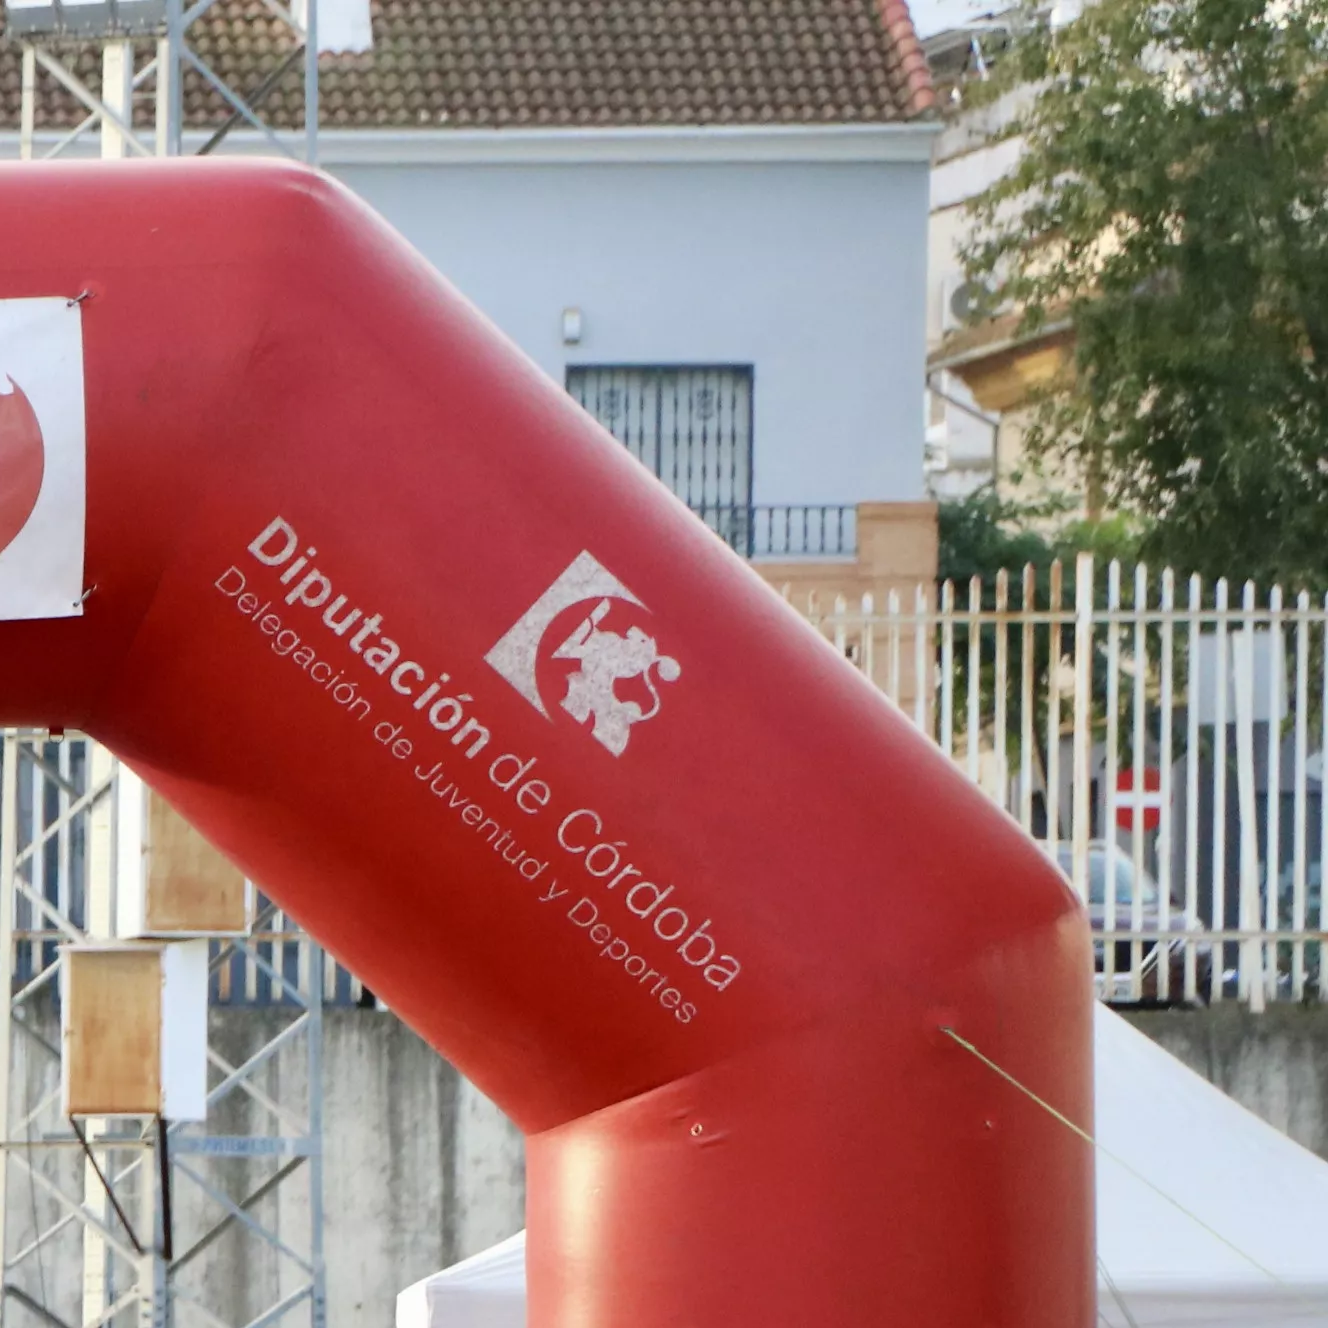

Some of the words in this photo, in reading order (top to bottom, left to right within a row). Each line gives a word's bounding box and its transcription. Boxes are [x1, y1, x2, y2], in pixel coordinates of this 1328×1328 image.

[214, 566, 371, 722] Delegación
[373, 719, 414, 760] de
[414, 761, 548, 881] Juventud
[538, 878, 569, 903] y
[567, 896, 697, 1024] Deportes
[247, 516, 491, 759] Diputación
[488, 753, 551, 814] de
[557, 808, 742, 992] Córdoba
